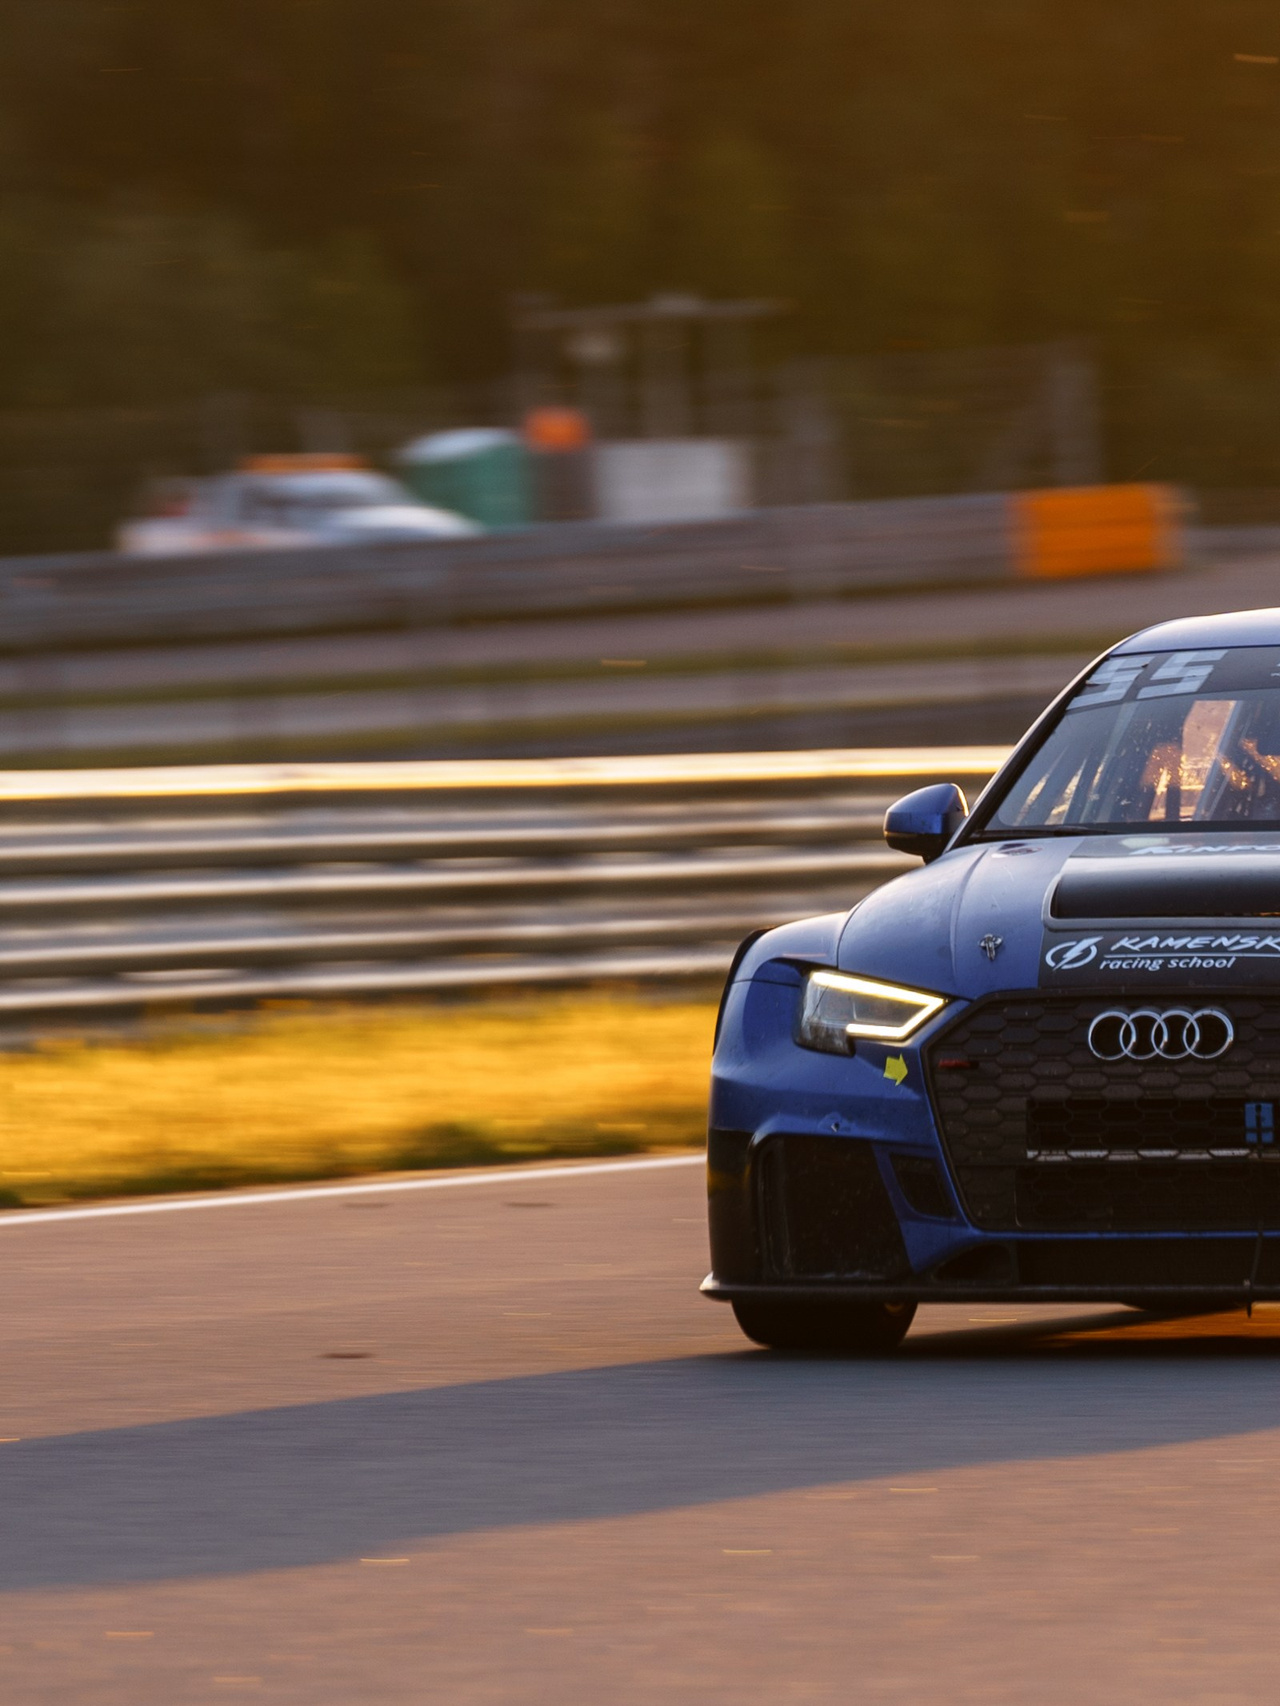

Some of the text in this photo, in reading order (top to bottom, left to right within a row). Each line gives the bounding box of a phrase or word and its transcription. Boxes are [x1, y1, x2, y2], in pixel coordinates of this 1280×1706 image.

[1065, 649, 1229, 711] 55
[1099, 955, 1237, 971] racing school
